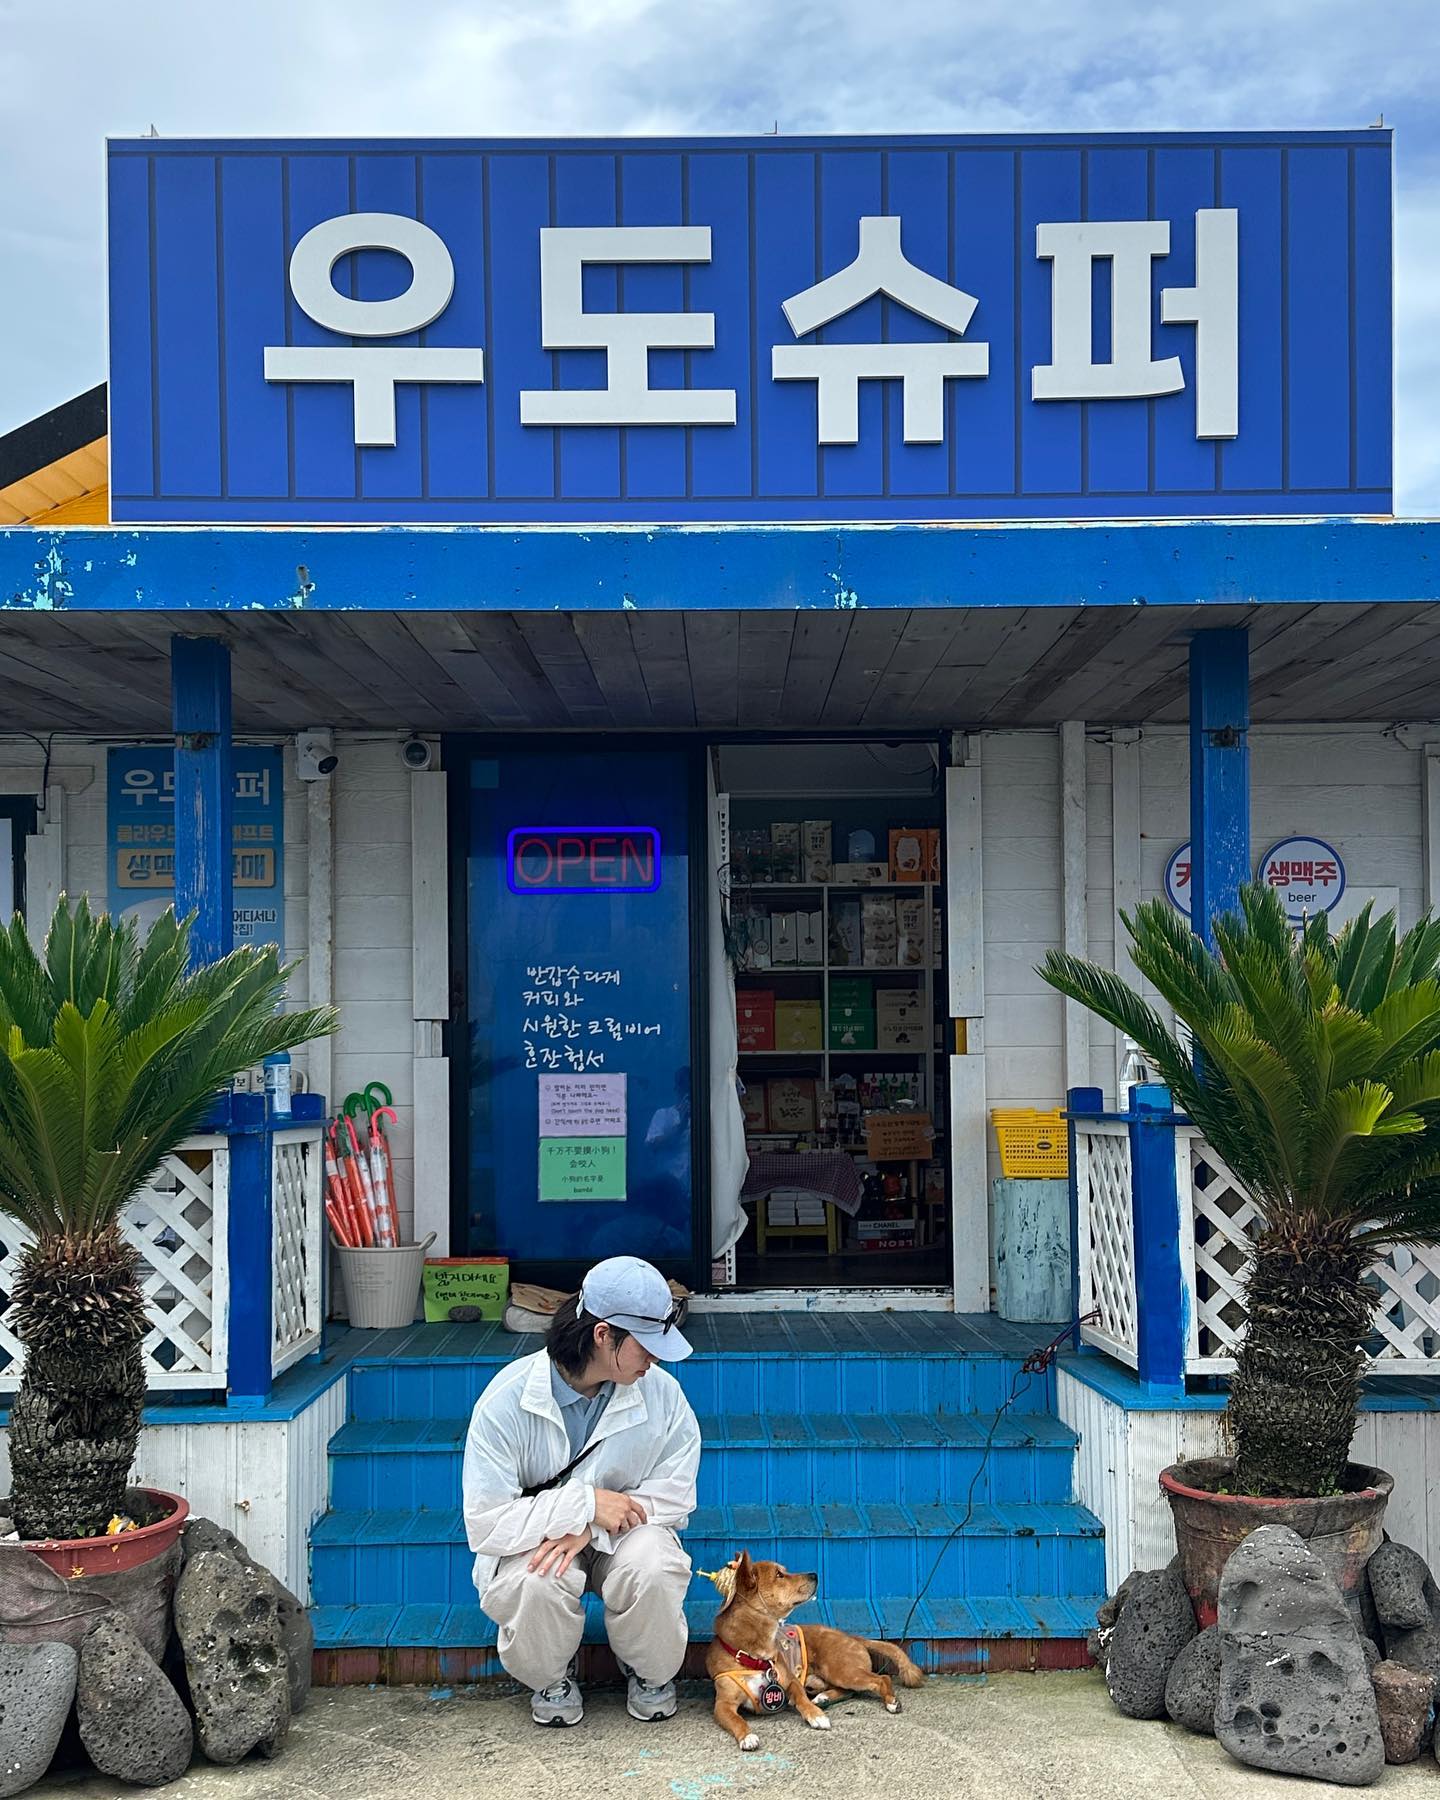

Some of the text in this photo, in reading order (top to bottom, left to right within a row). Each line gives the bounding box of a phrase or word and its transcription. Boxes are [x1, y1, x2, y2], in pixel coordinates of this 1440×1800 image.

[263, 208, 1239, 447] 우도슈퍼
[121, 769, 270, 806] 우퍼
[515, 836, 654, 883] OPEN
[1267, 861, 1338, 887] 생맥주
[1288, 892, 1317, 903] beer
[522, 990, 585, 1007] 커피와
[522, 1012, 582, 1039] 시원한
[765, 1691, 782, 1704] 밤비
